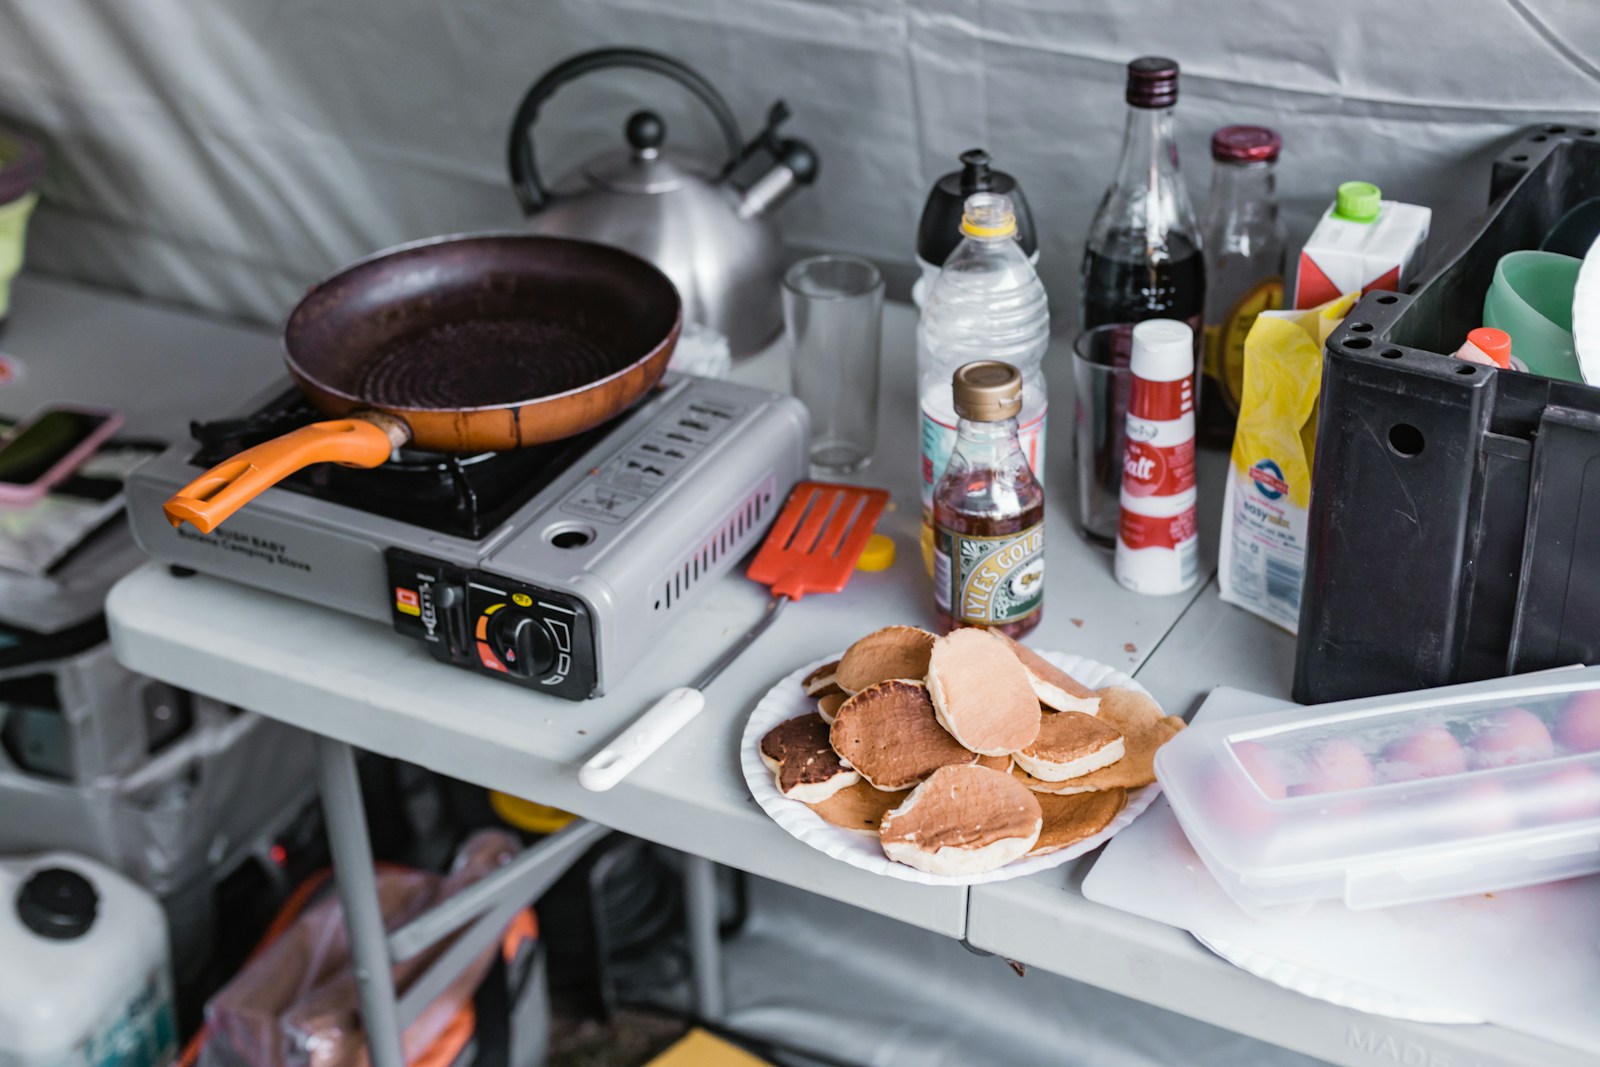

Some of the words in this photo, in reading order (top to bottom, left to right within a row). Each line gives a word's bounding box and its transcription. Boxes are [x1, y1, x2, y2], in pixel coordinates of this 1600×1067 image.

[178, 528, 218, 546] Butane
[222, 539, 275, 564] Camping
[277, 554, 311, 572] Stove
[252, 536, 286, 552] BABY
[514, 593, 531, 605] OFF
[966, 567, 999, 618] LYLE'S
